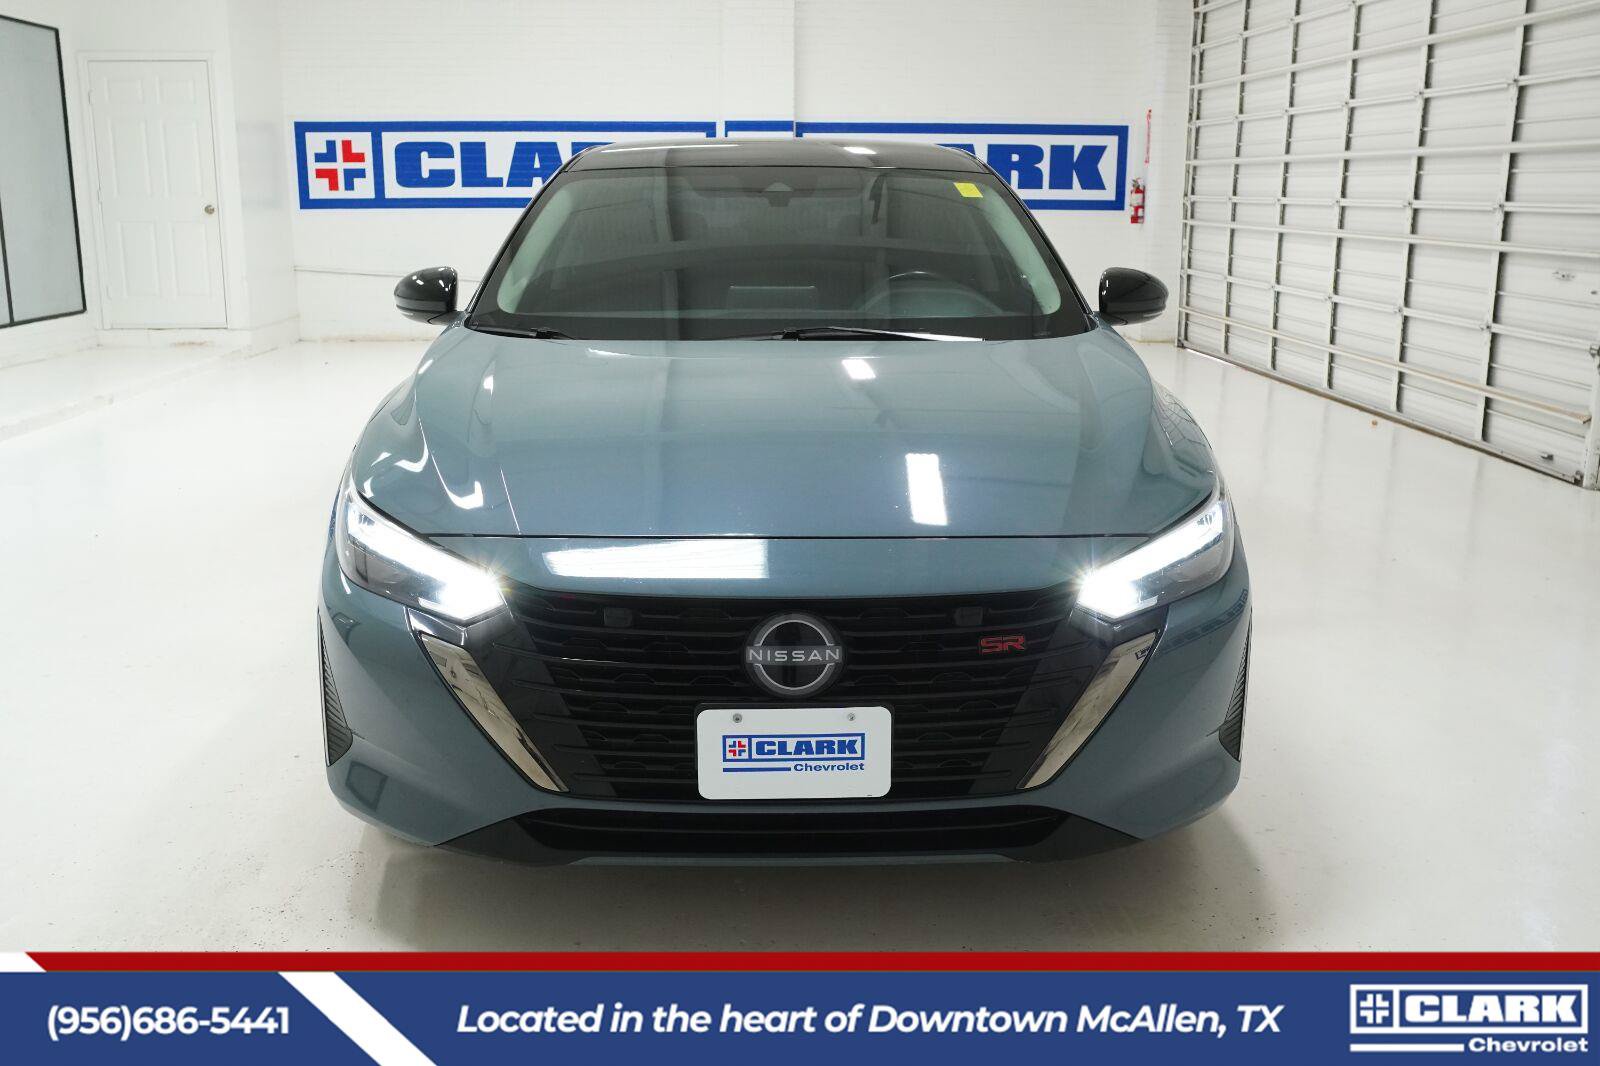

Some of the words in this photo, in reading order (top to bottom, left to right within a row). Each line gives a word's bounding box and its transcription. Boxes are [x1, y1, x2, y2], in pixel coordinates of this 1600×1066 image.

[394, 141, 616, 188] CLA
[937, 143, 1107, 190] RK
[979, 635, 1025, 654] SR
[748, 648, 840, 662] NISSAN
[755, 739, 858, 756] CLARK
[793, 762, 865, 772] Chevrolet
